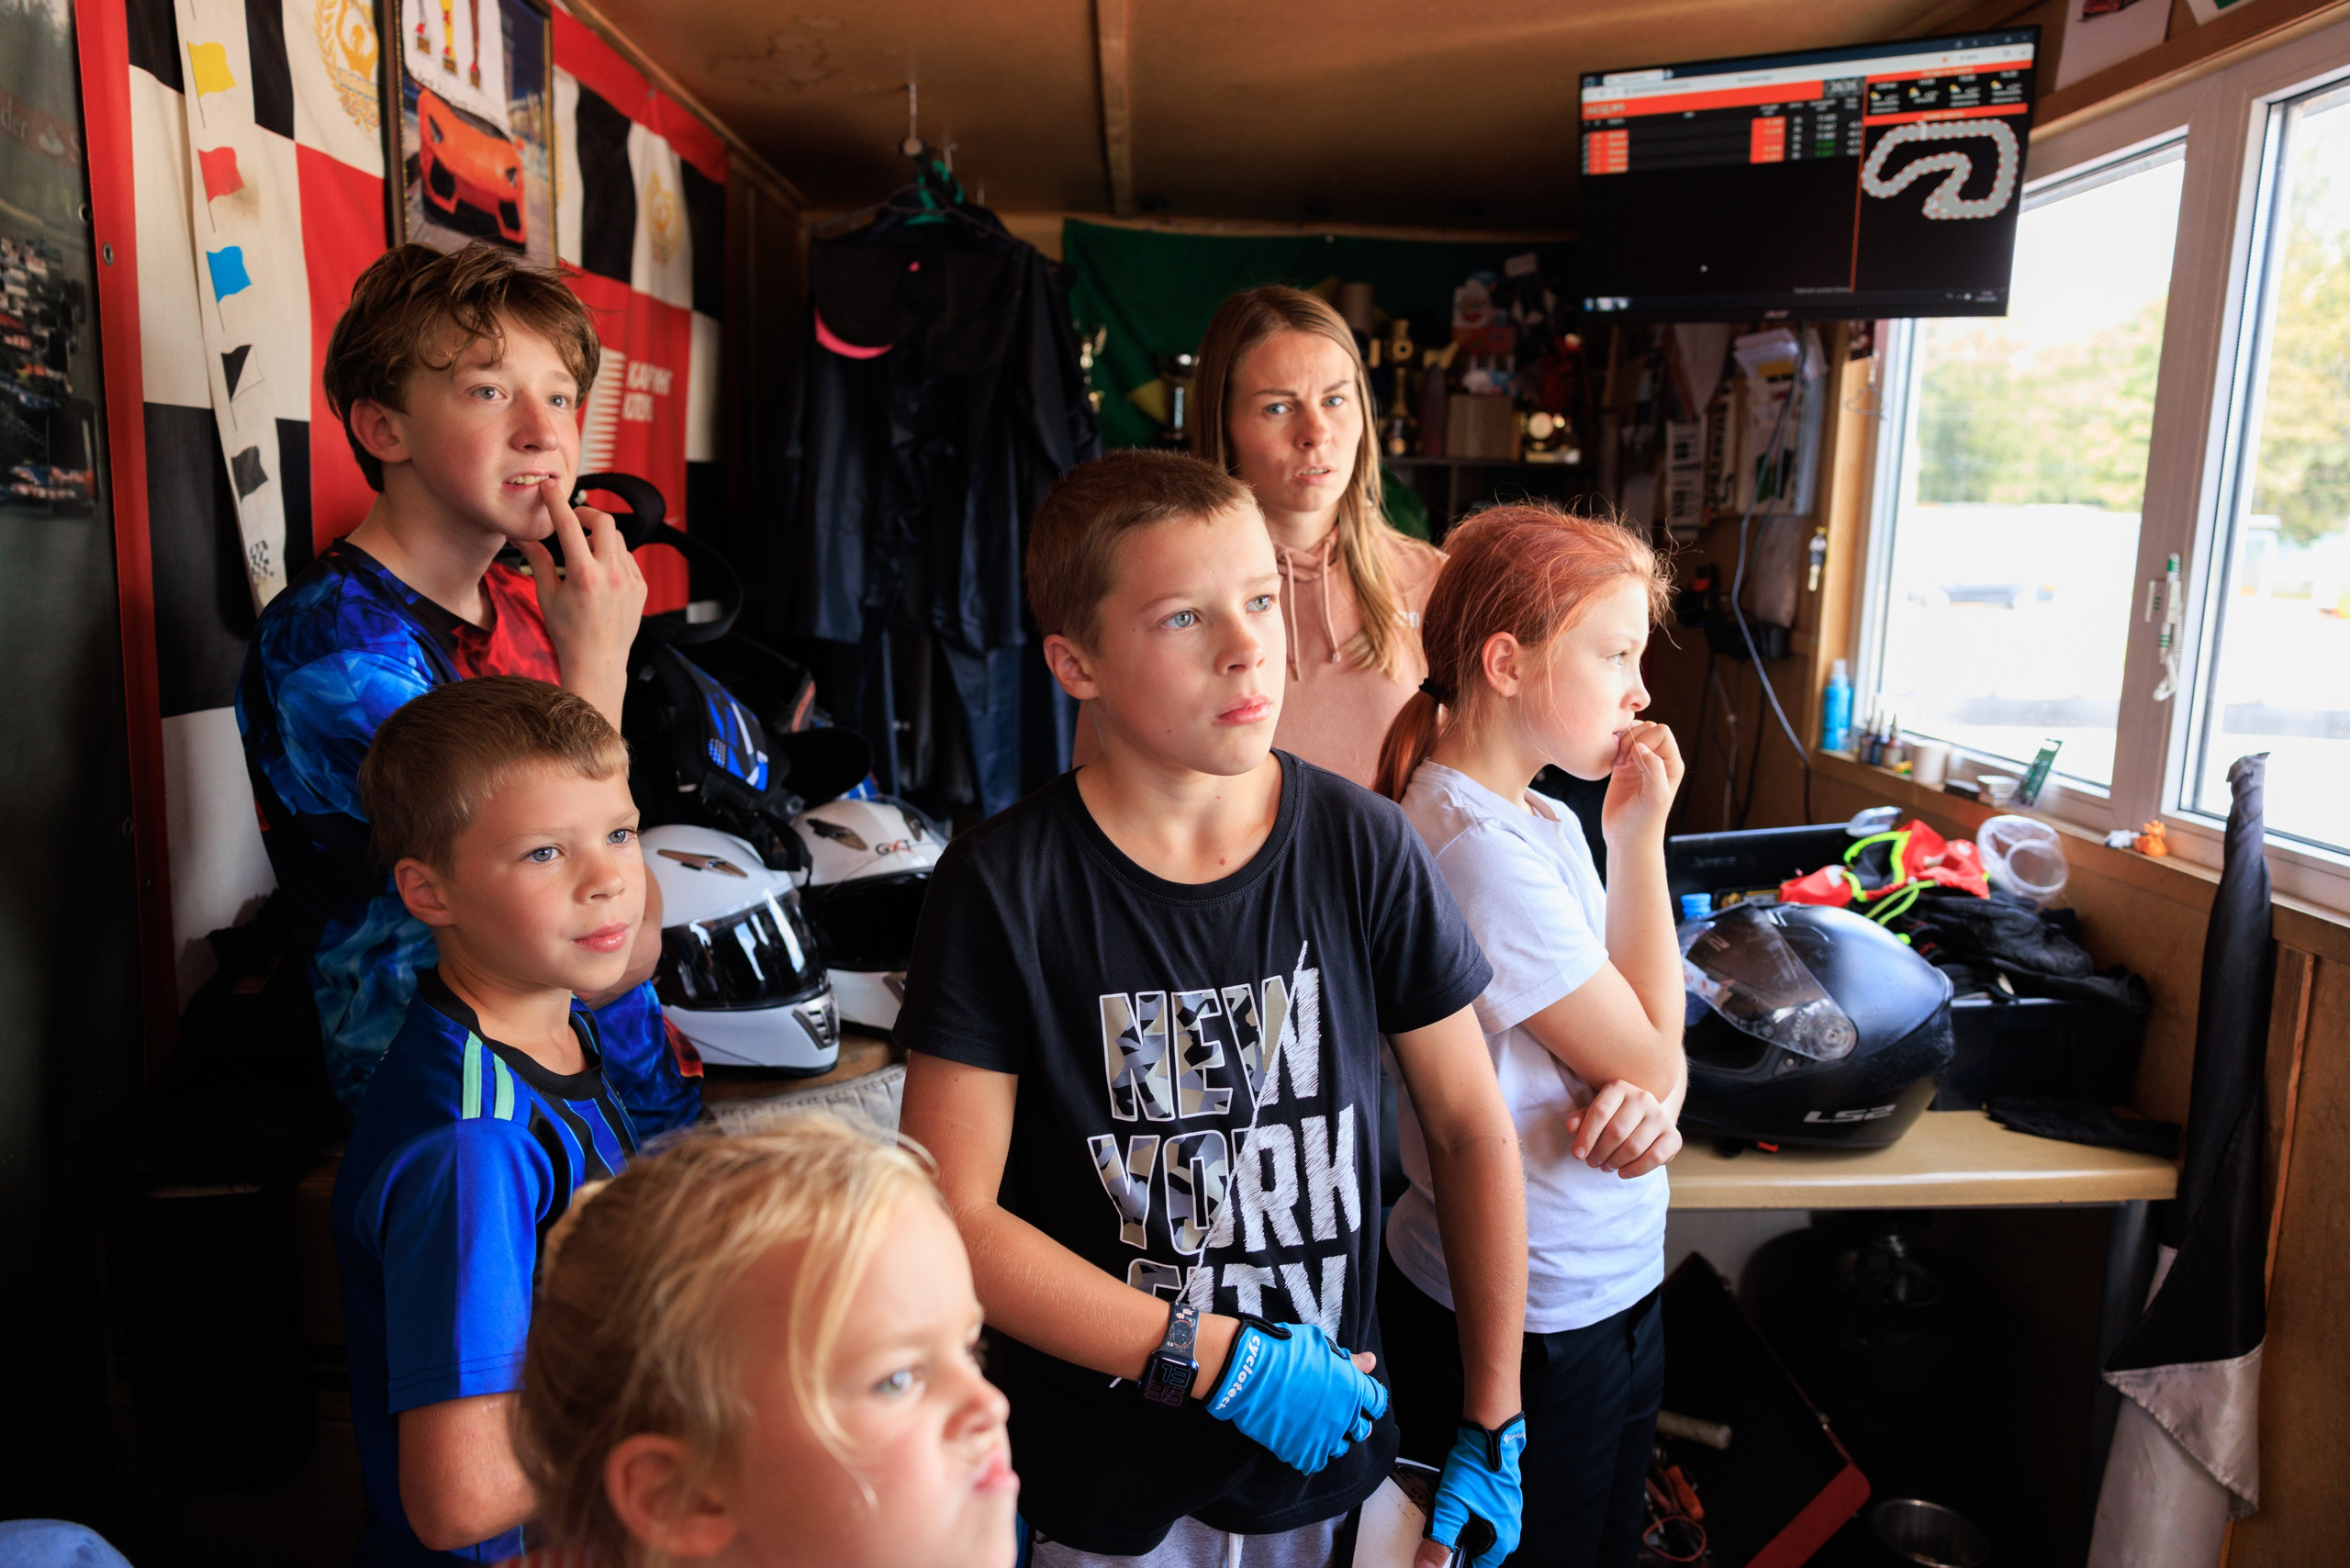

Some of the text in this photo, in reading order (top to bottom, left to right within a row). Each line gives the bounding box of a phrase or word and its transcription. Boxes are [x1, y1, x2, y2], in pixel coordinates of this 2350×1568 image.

[1100, 967, 1320, 1121] NEW
[1804, 1104, 1897, 1123] LS2
[1087, 1103, 1361, 1255] YORK
[1161, 1363, 1192, 1388] 13
